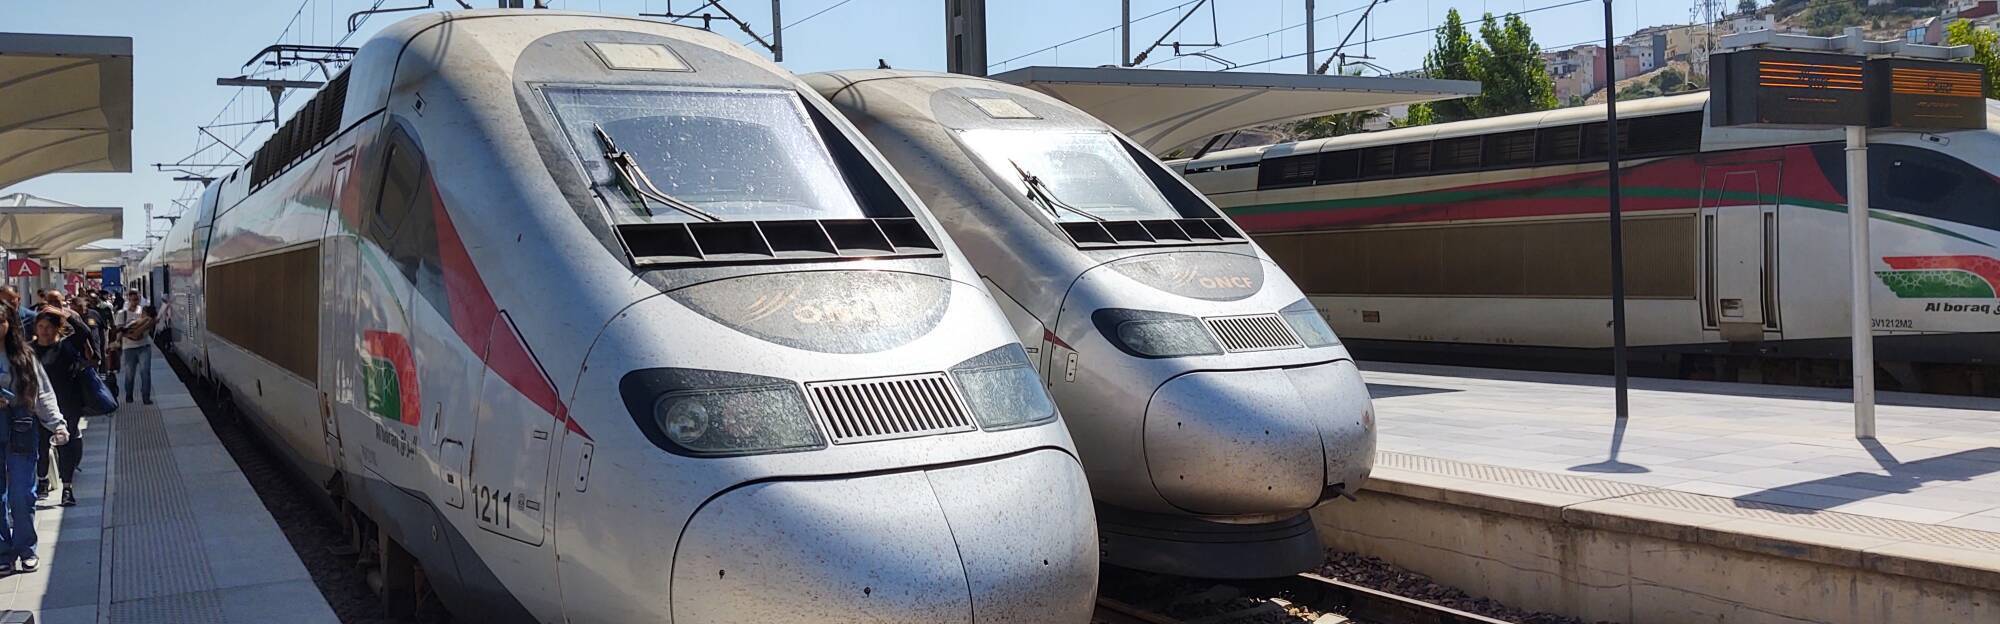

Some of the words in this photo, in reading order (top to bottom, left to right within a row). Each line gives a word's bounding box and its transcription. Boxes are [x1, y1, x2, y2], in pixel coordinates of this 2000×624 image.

[18, 261, 32, 275] A
[1199, 276, 1253, 289] ONCF
[1925, 302, 1941, 312] Al
[1943, 302, 1991, 314] boraq
[472, 484, 512, 529] 1211
